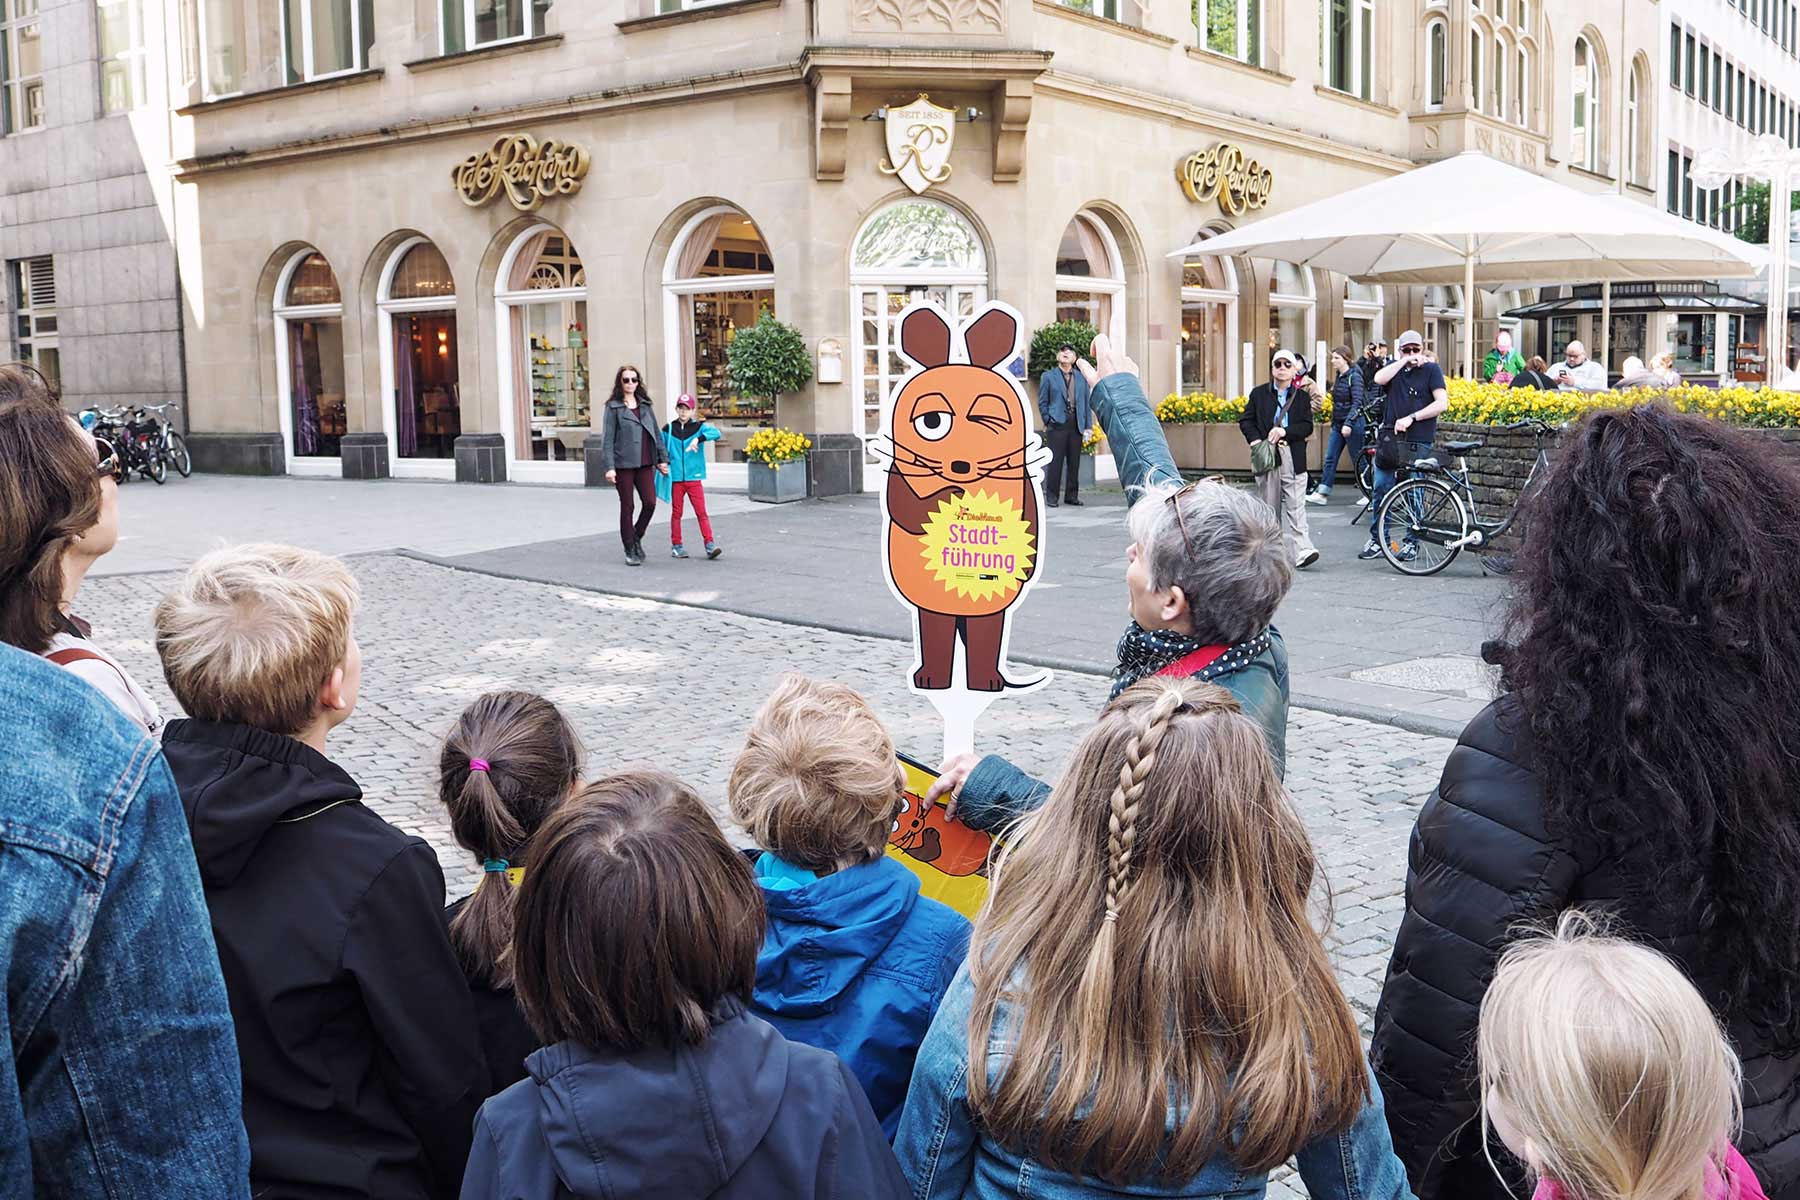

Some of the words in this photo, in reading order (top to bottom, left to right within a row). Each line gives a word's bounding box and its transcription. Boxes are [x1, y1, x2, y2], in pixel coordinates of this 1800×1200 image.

[898, 110, 920, 120] SEIT
[923, 110, 944, 120] 1855
[488, 132, 592, 212] Reichard
[1214, 142, 1273, 217] Reichard
[948, 524, 1008, 546] Stadt-
[942, 546, 1015, 574] führung
